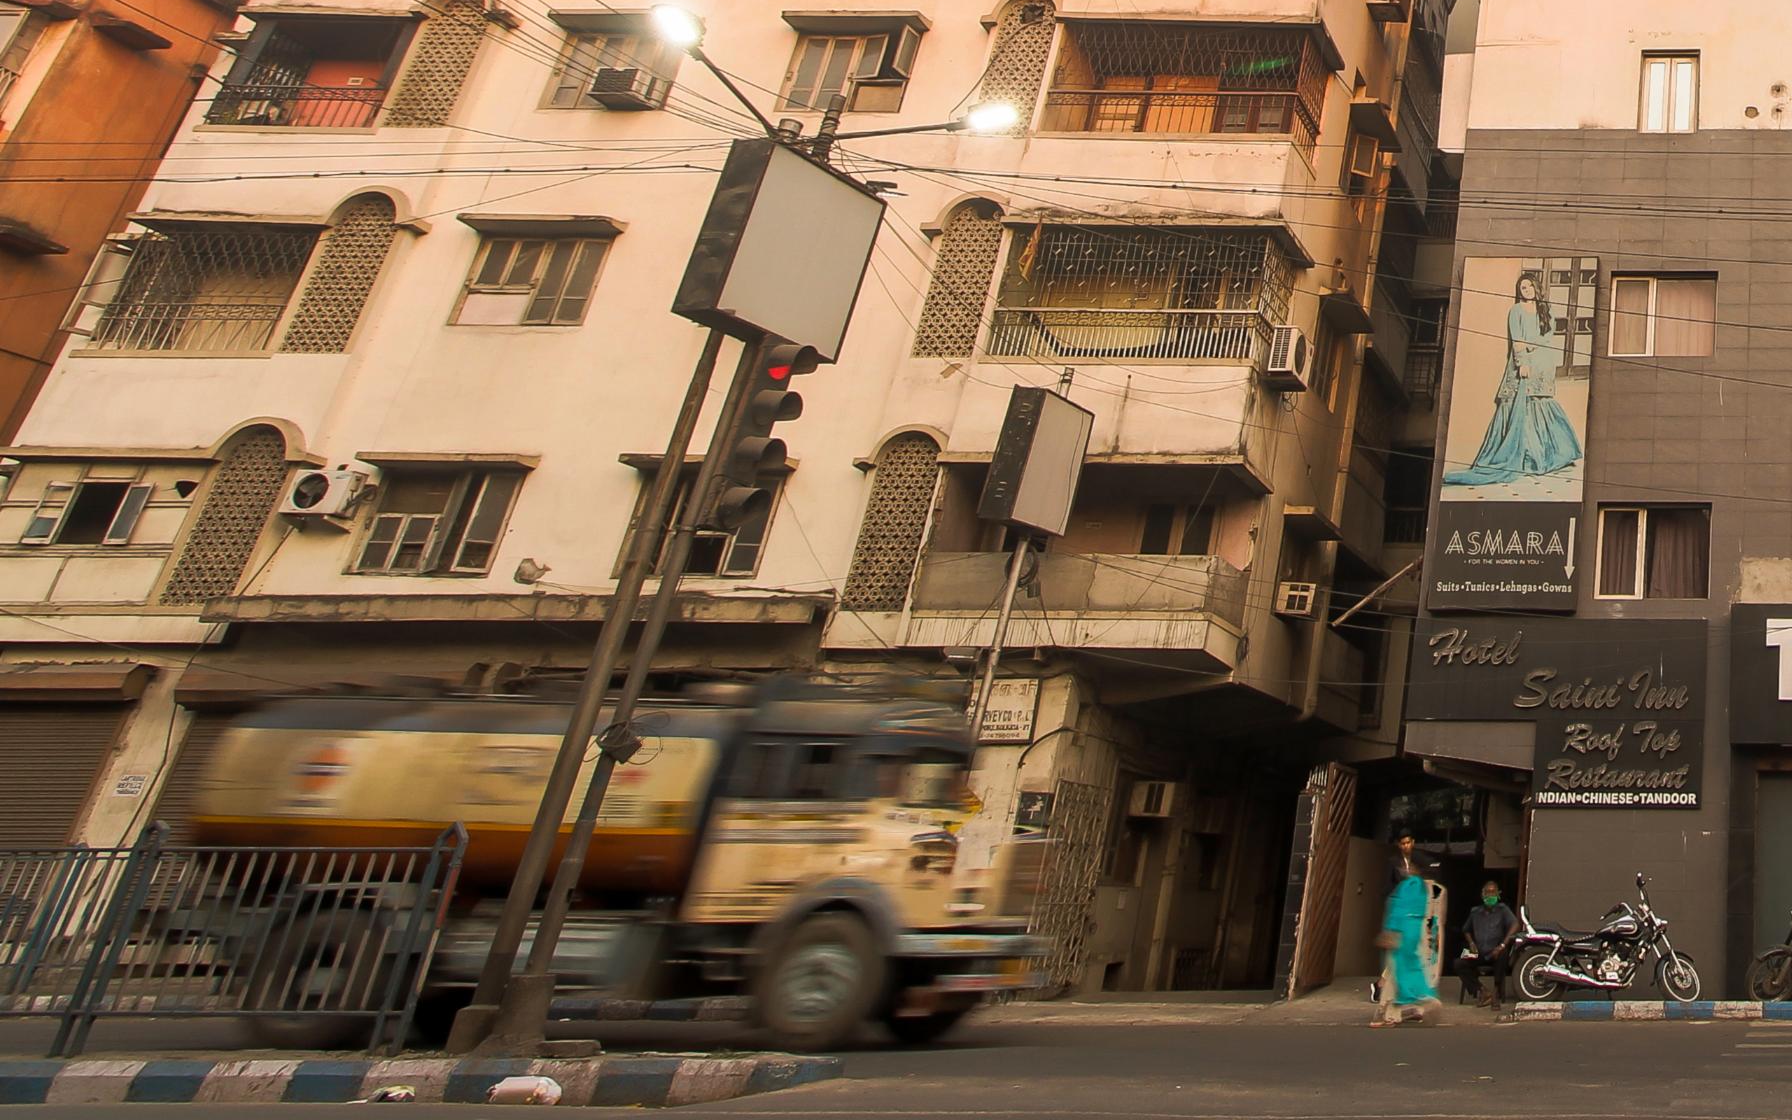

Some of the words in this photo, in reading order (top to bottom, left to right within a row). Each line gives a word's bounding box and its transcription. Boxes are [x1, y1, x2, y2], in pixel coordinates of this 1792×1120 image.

[1444, 529, 1565, 556] ASMARA
[1428, 627, 1523, 666] Hotel
[1513, 667, 1625, 709] Saini
[1628, 668, 1689, 710] Inn
[1561, 722, 1625, 761] Roof
[1632, 720, 1681, 759] Top
[1544, 758, 1690, 791] Restaurant
